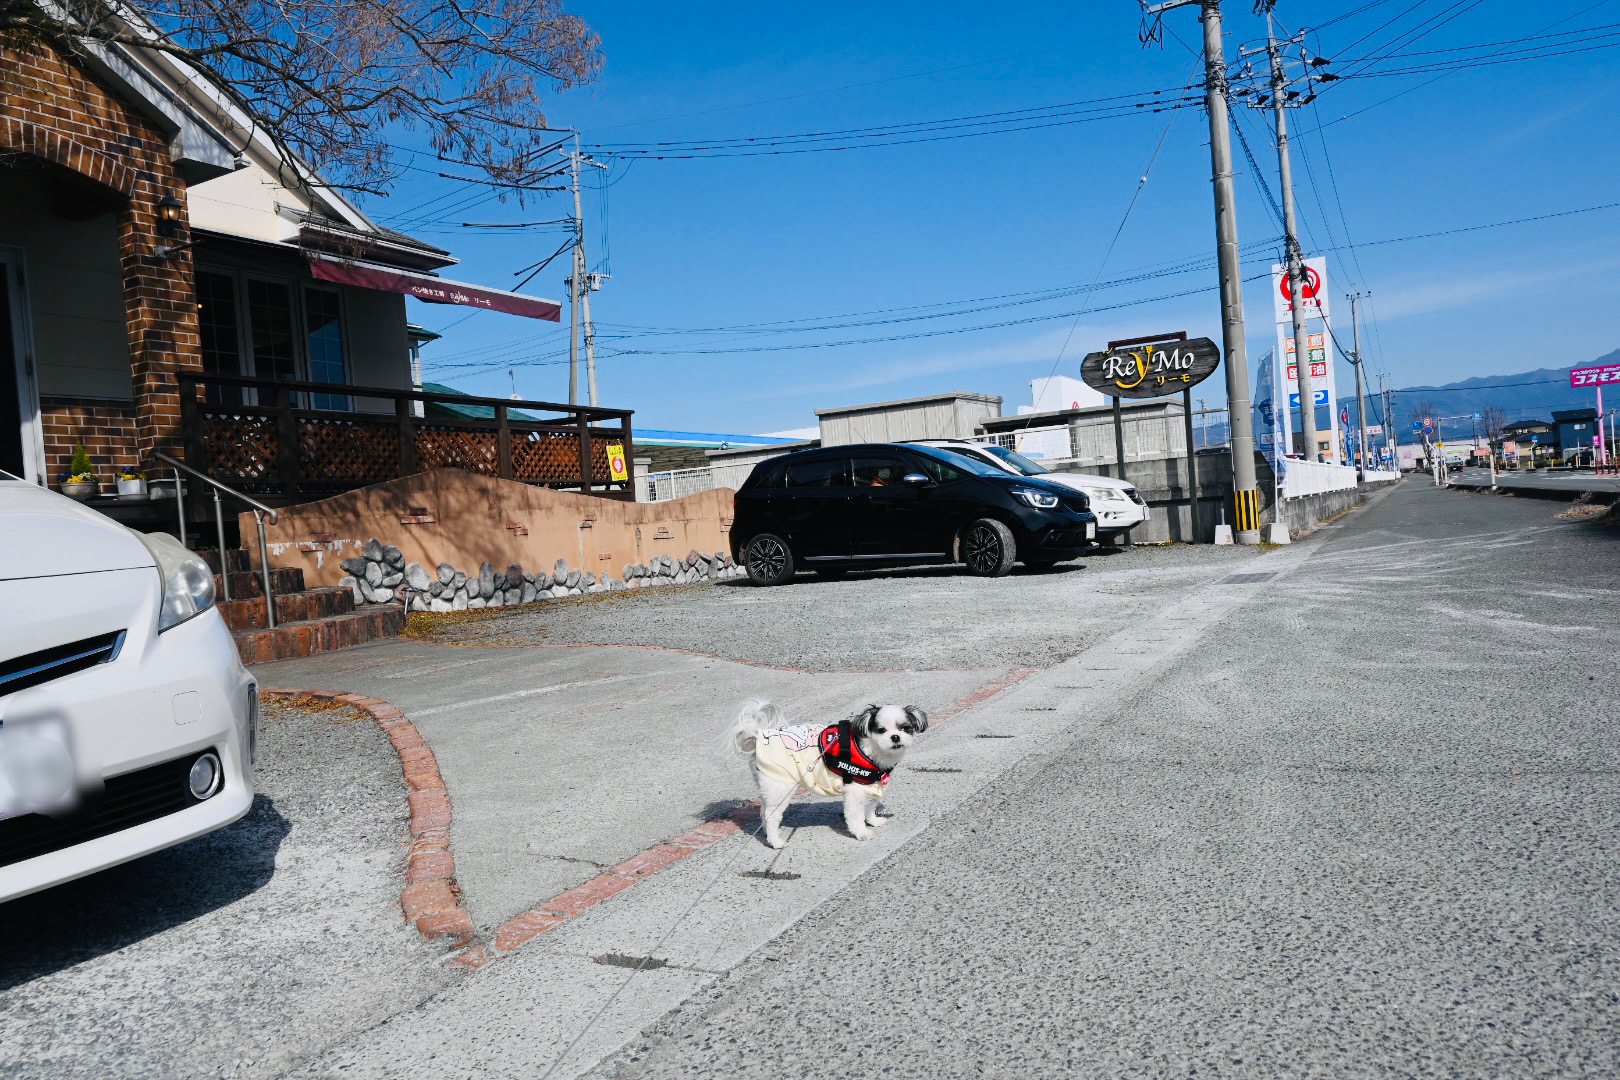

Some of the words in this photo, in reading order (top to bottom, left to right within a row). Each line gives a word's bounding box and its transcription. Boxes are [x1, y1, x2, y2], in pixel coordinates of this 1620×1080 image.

[1157, 373, 1191, 386] リーモ
[1574, 372, 1620, 385] コスモス
[1312, 391, 1325, 405] P
